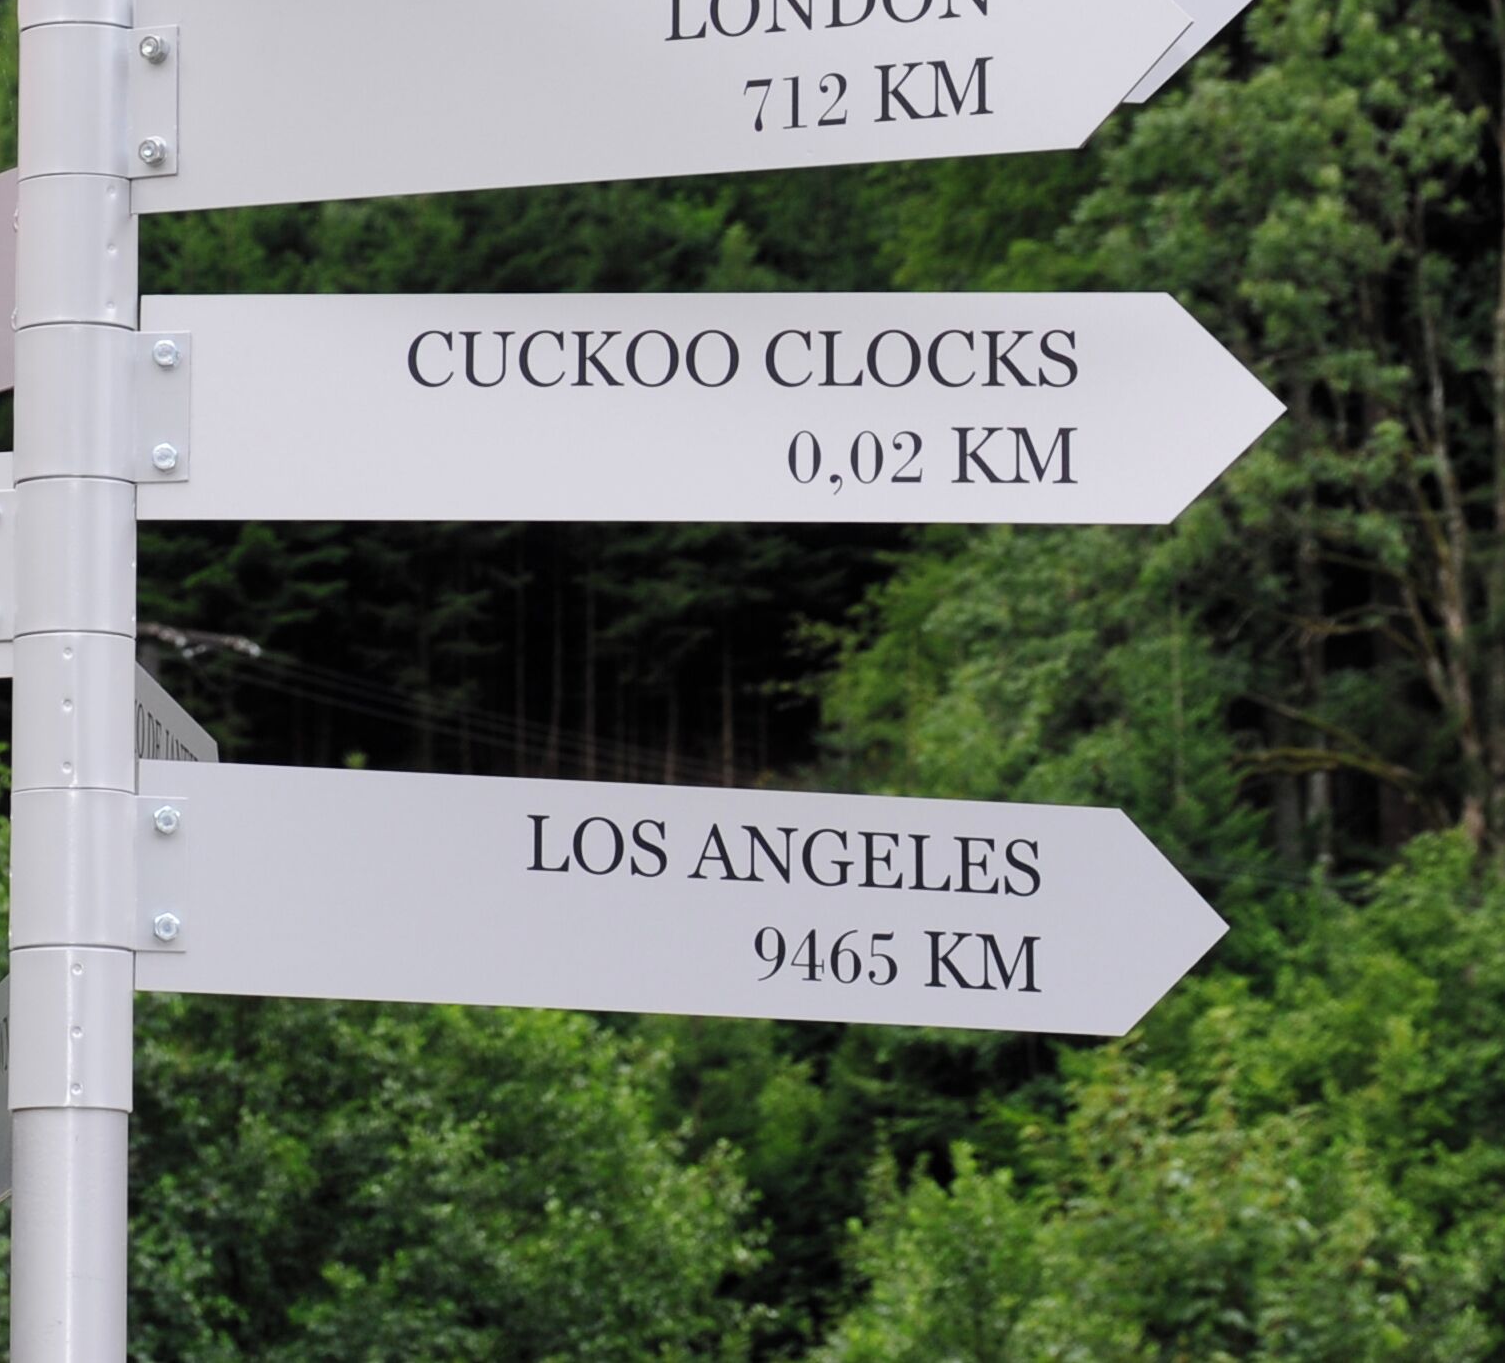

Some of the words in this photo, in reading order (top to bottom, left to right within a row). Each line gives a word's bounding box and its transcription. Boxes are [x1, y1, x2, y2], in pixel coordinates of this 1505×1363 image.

[744, 73, 847, 132] 712
[875, 57, 993, 122] KM
[408, 330, 739, 387] CUCKOO
[766, 330, 1077, 387] CLOCKS
[788, 431, 922, 494] 0,02
[951, 427, 1077, 483] KM
[527, 815, 667, 877] LOS
[688, 824, 1040, 896] ANGELES
[755, 927, 897, 985] 9465
[924, 931, 1041, 992] KM
